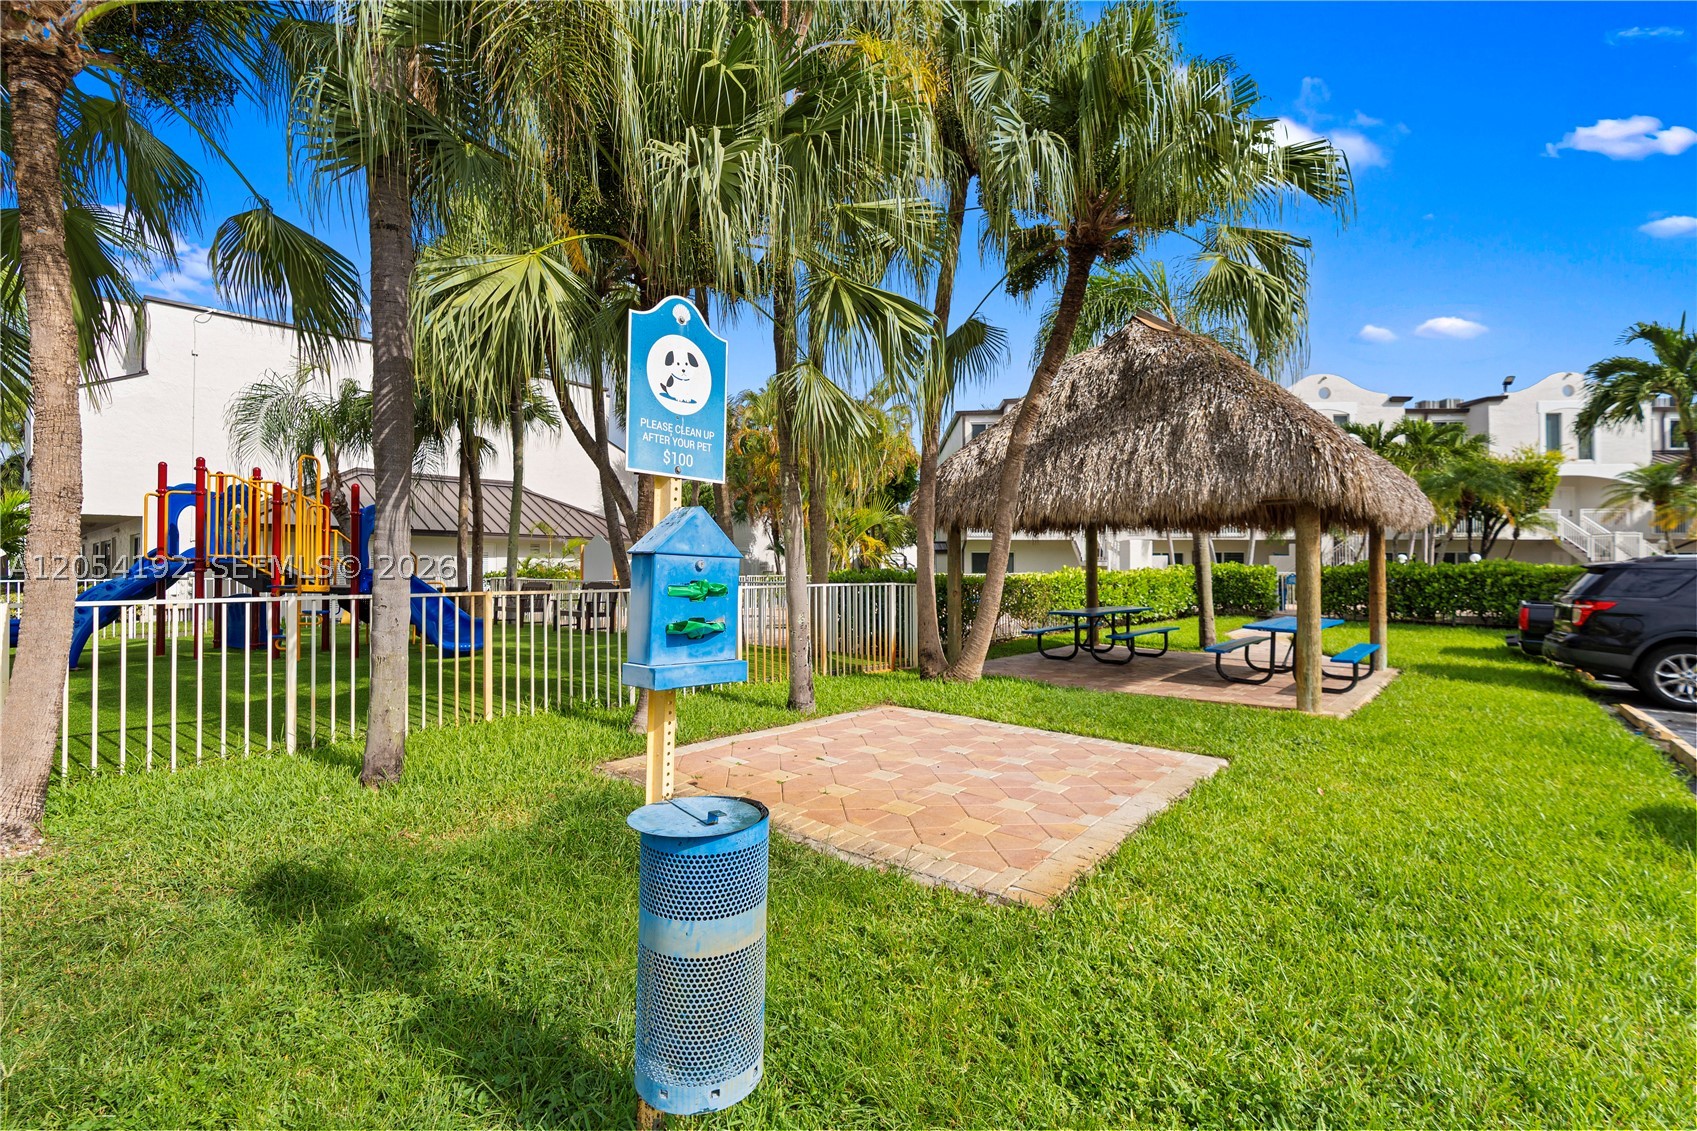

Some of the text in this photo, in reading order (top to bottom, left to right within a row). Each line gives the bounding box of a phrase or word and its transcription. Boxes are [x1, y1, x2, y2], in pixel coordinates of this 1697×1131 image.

[640, 418, 715, 440] PLEASE CLEAN UP
[642, 432, 712, 452] AFTER YOUR PET
[663, 449, 693, 467] $100
